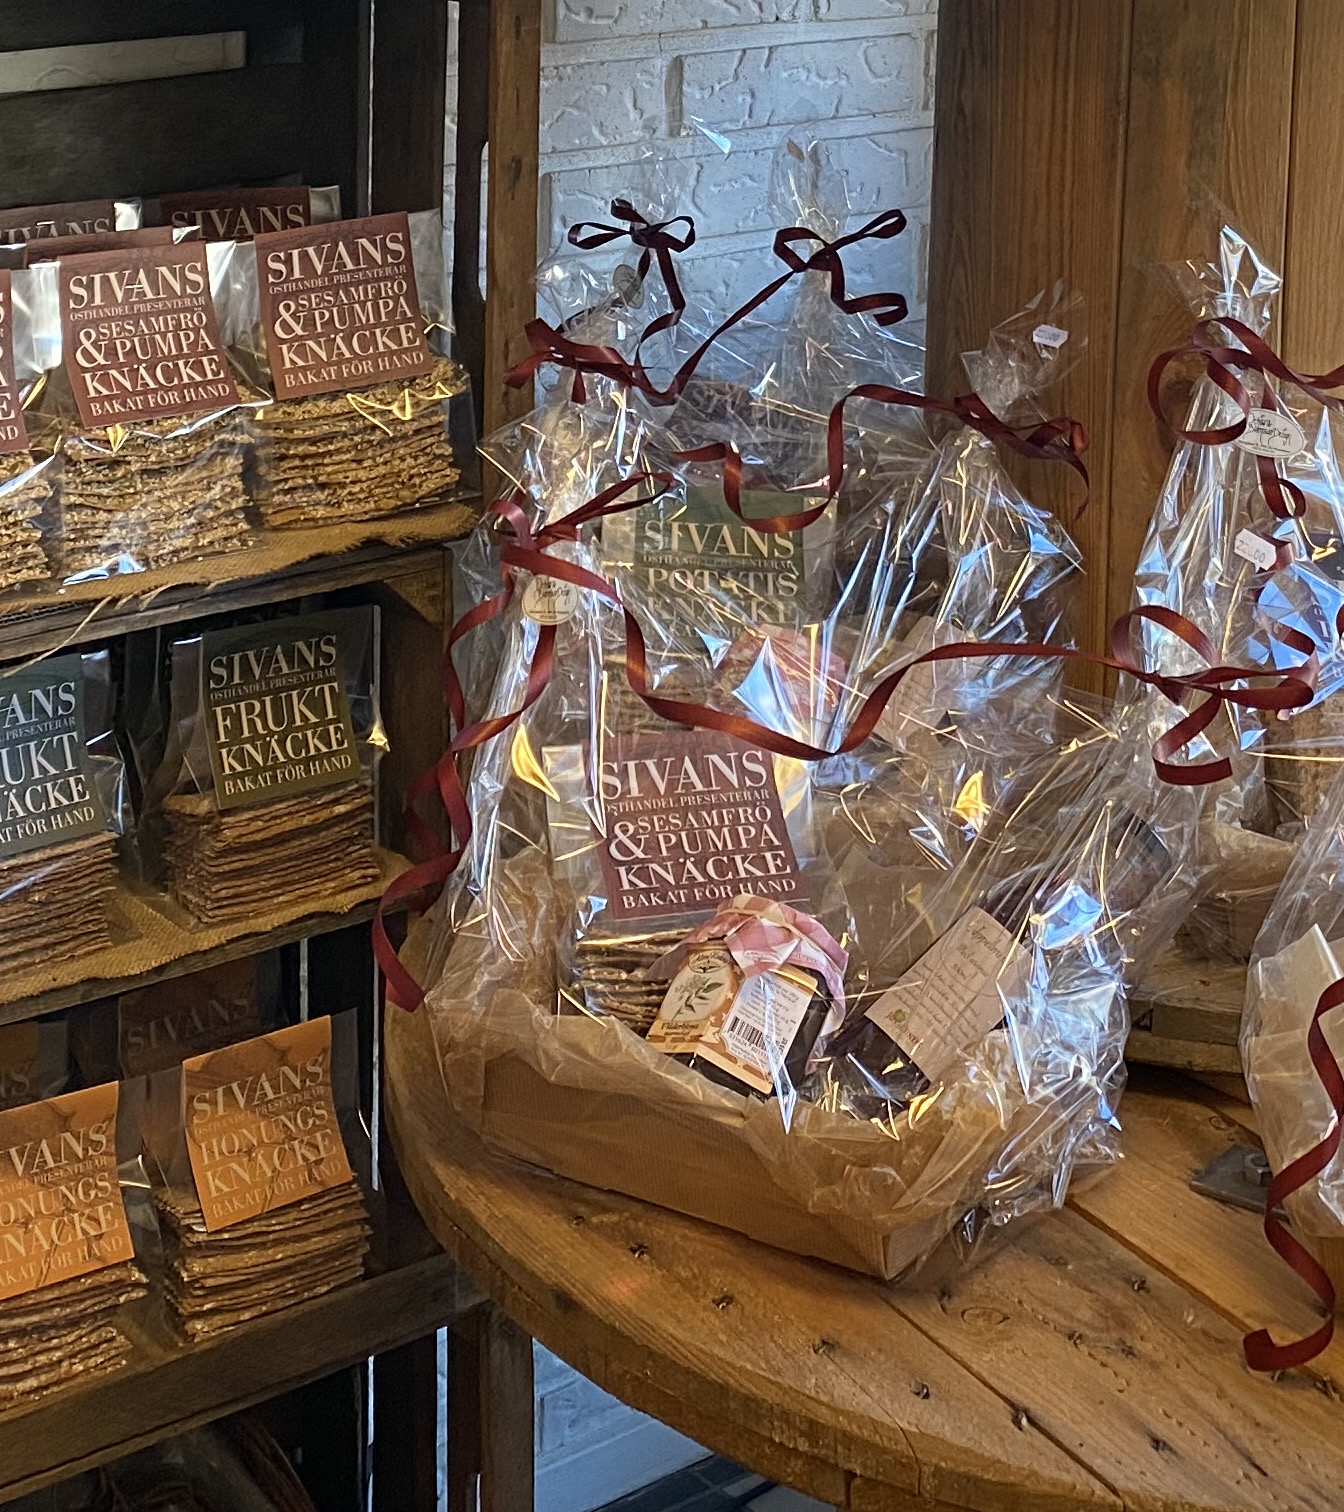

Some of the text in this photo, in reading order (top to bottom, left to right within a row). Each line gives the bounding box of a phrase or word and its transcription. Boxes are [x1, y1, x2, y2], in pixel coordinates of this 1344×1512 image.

[267, 232, 406, 283] SIVANS
[69, 262, 204, 310] SIVANS
[298, 277, 408, 312] SESAMFRÖ
[98, 309, 207, 340] SESAMFRÖ
[274, 295, 413, 340] & PUMPA
[75, 328, 215, 369] & PUMPA
[279, 323, 421, 370] KNÄCKE
[82, 355, 224, 399] KNÄCKE
[284, 351, 424, 388] BAKAT FÖR HAND
[89, 383, 229, 417] BAKAT FÖR HAND
[644, 520, 795, 559] SIVANS
[210, 635, 337, 689] SIVANS
[6, 716, 76, 741] PRESENTERAR
[212, 683, 339, 744] FRUKT
[219, 723, 349, 777] KNÄCKE
[225, 754, 352, 795] BAKAT FÖR HAND
[603, 749, 768, 800] SIVANS
[16, 818, 48, 837] FÖR
[52, 806, 95, 831] HAND
[608, 820, 783, 862] & PUMPA
[638, 804, 772, 836] SESAMFRÖ
[613, 849, 791, 892] KNÄCKE
[621, 877, 797, 910] BAKAT FÖR HAND
[192, 1055, 324, 1124] SIVANS
[199, 1100, 328, 1166] HONUNGS
[212, 1159, 342, 1219] BAKAT HAND
[77, 1236, 123, 1264] HAND
